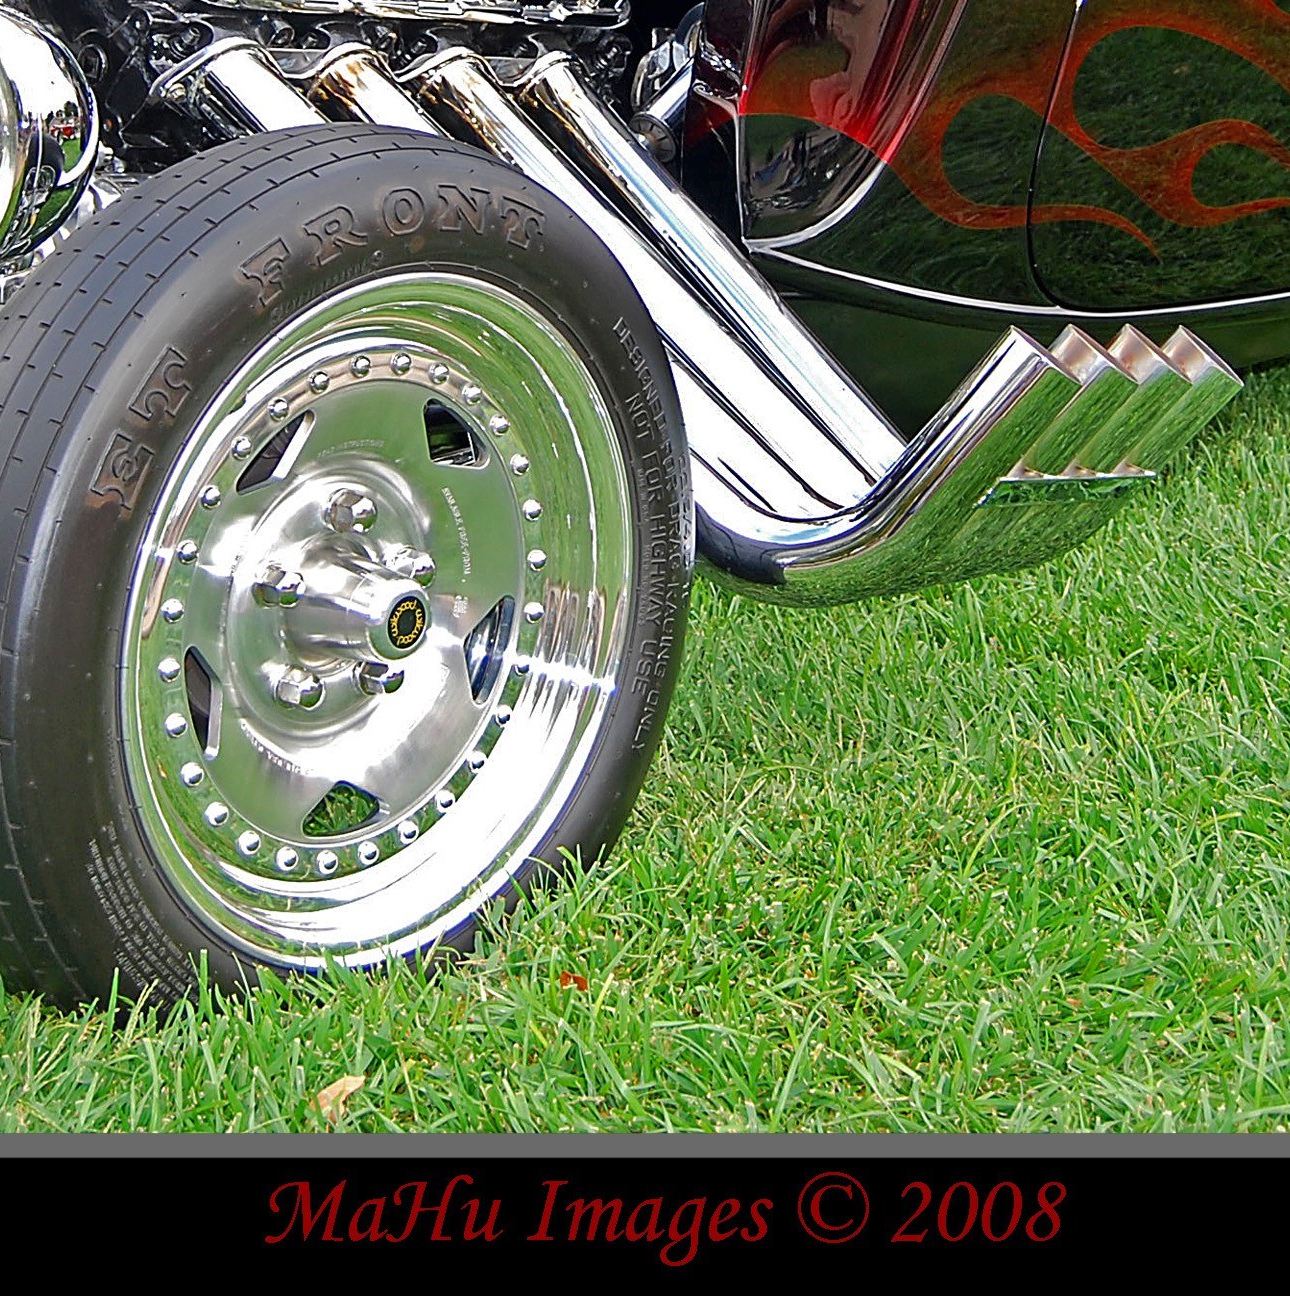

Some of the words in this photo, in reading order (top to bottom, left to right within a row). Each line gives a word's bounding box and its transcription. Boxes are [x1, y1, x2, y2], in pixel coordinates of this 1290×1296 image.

[238, 183, 546, 307] FRONT
[612, 317, 666, 431] DESIGNED
[625, 393, 655, 440] NOT
[642, 450, 665, 503] FOR
[661, 439, 678, 491] FOR
[644, 513, 666, 629] HIGHWAY
[632, 640, 657, 695] USE
[632, 688, 660, 750] ONLY
